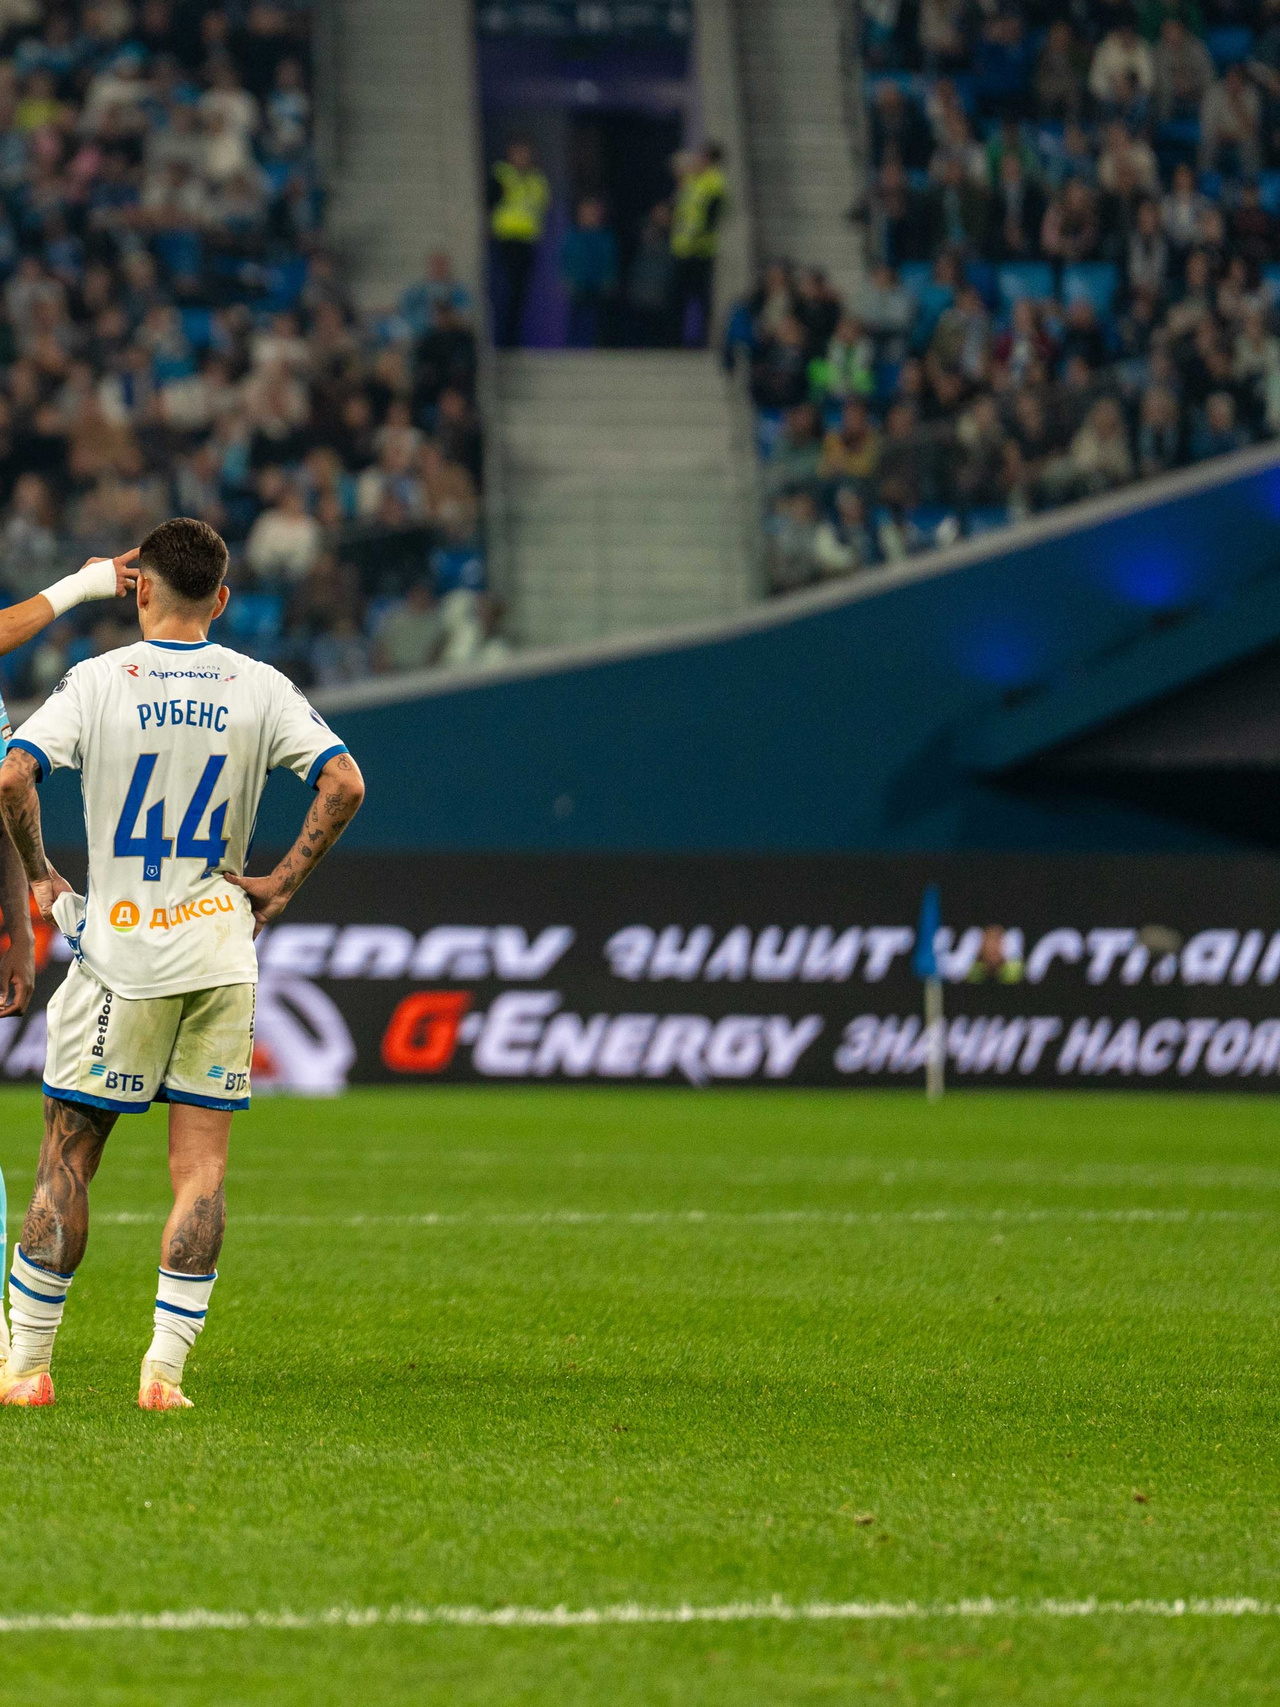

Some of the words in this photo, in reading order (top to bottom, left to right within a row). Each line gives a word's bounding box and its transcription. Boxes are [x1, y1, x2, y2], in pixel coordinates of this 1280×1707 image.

[136, 699, 229, 733] РУБЕНС
[113, 753, 230, 881] 44
[92, 991, 113, 1058] BetBoo
[105, 1071, 145, 1092] ВТБ
